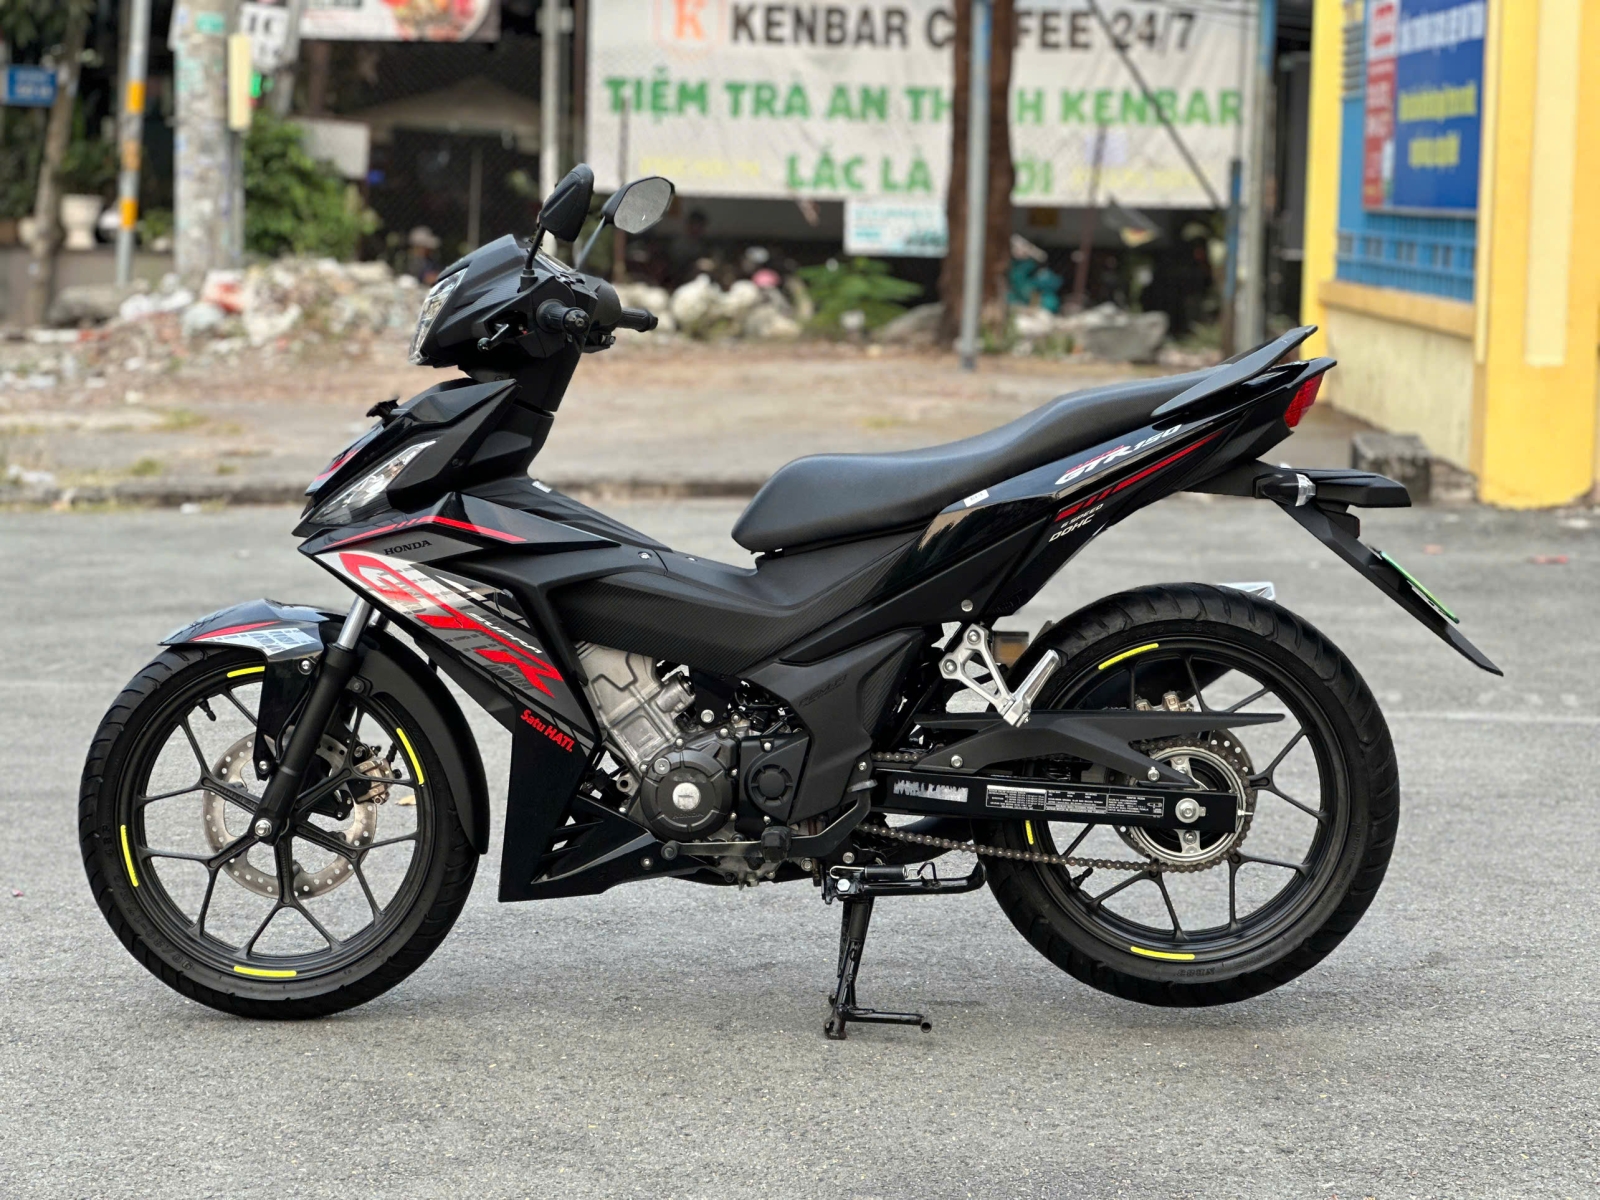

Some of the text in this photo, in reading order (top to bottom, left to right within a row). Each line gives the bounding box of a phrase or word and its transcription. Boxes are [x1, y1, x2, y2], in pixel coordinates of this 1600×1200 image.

[732, 5, 909, 48] KENBAR
[1062, 88, 1241, 126] KENBAR
[1048, 513, 1096, 542] DOHC
[383, 540, 433, 555] HONDA
[520, 709, 547, 733] Satu
